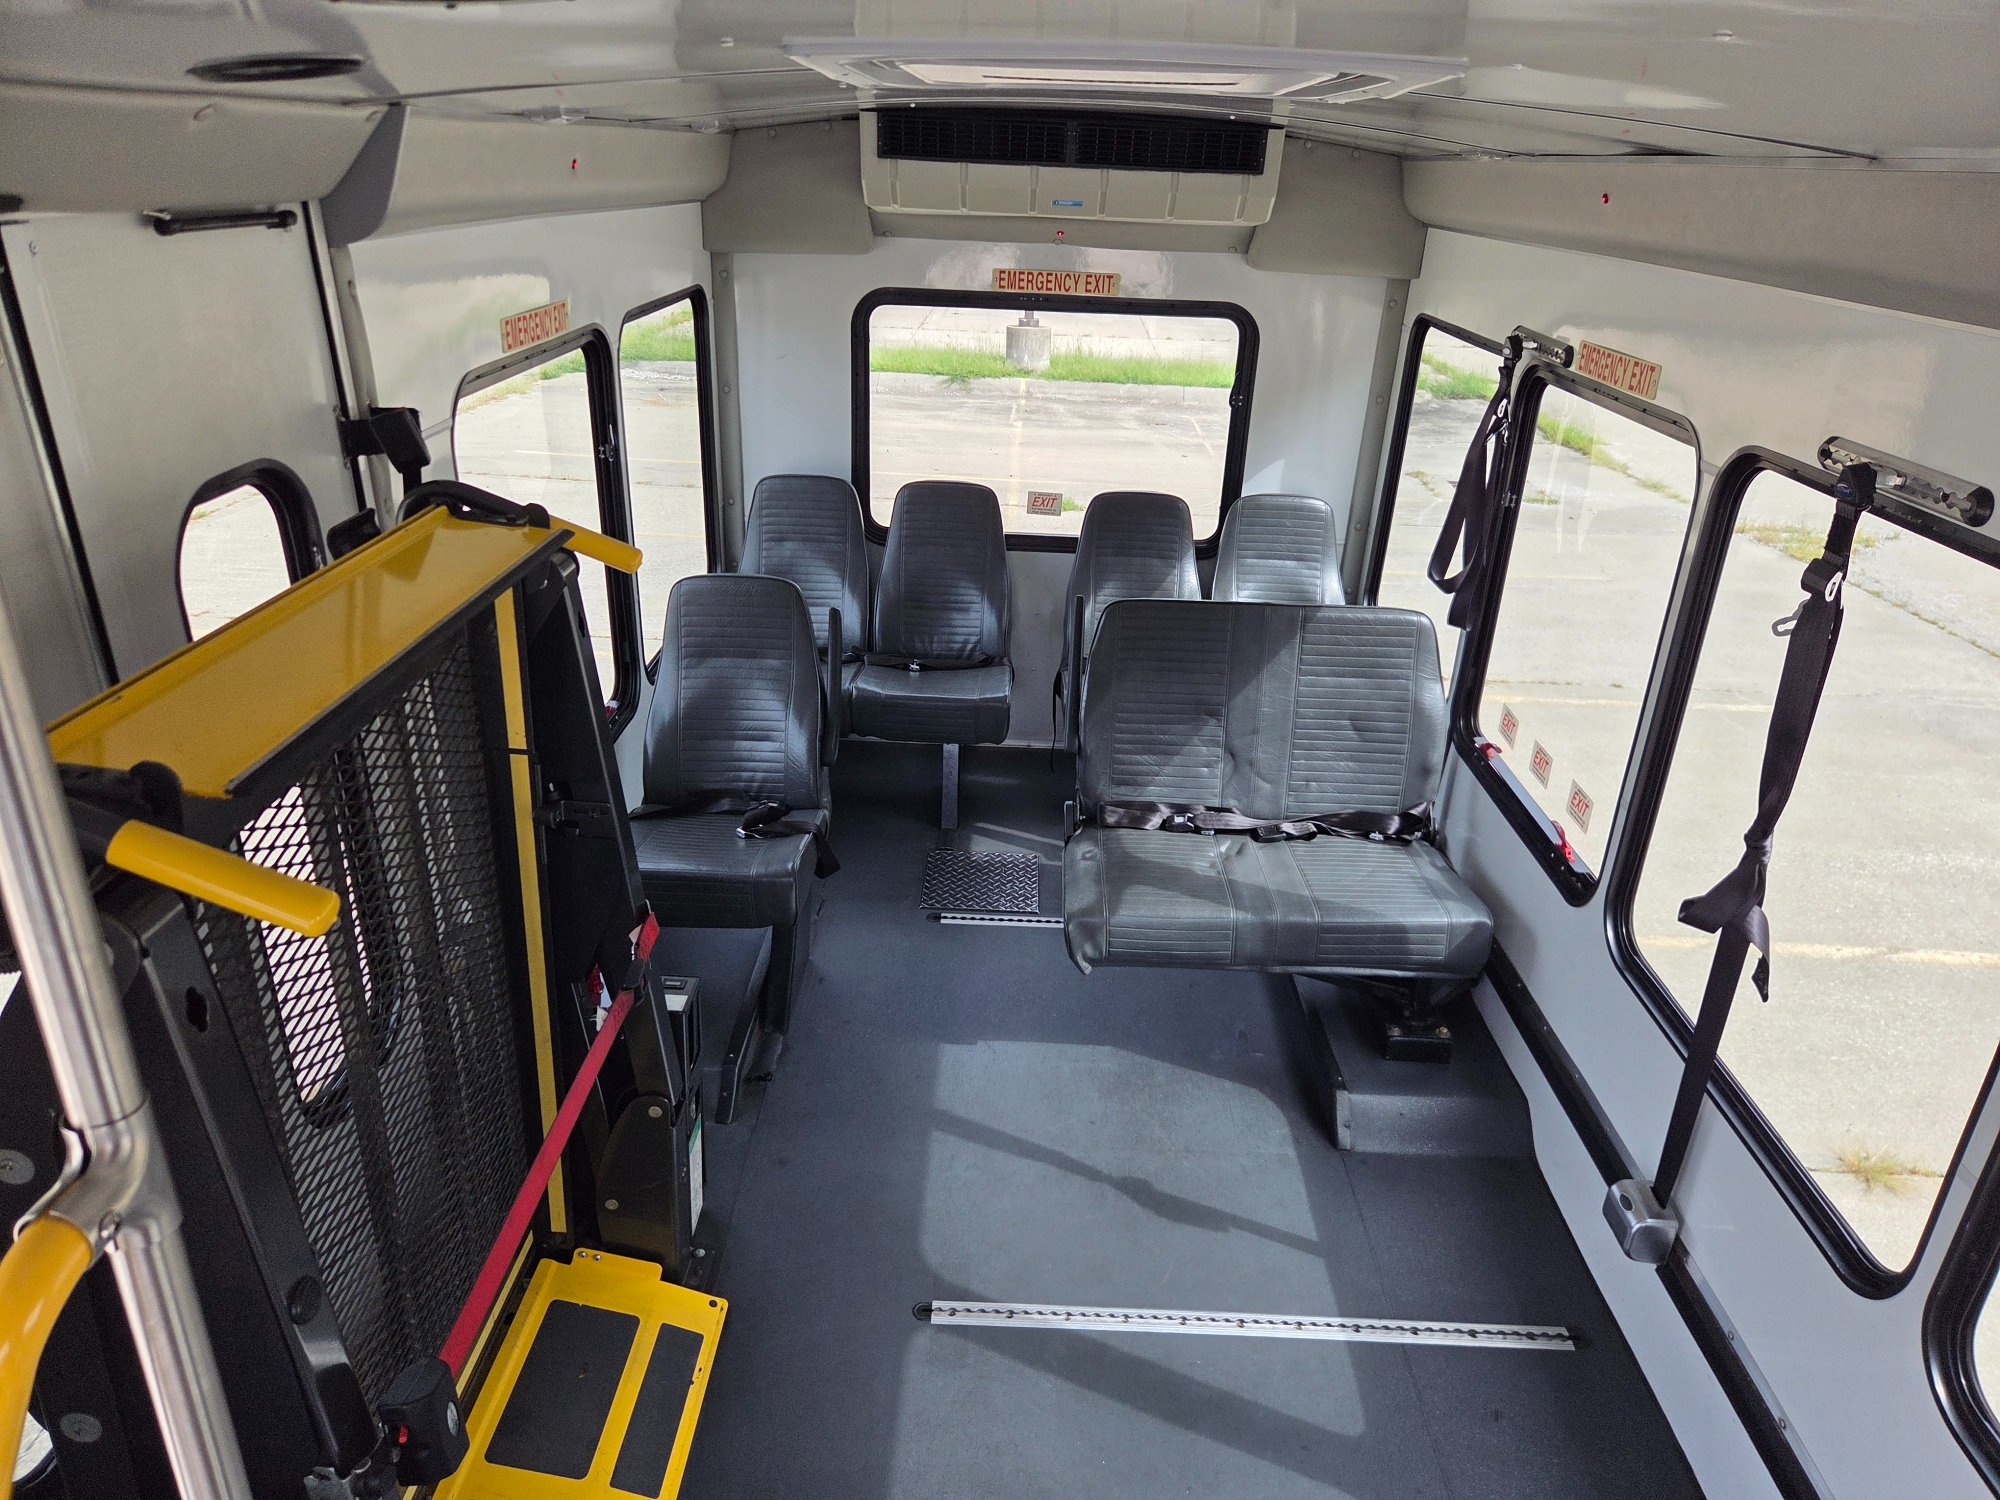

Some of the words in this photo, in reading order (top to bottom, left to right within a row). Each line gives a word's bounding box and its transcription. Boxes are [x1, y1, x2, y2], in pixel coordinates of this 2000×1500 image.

[998, 270, 1081, 293] EMERGENCY
[1084, 274, 1114, 294] EXIT
[504, 306, 552, 350] EMERGENCY
[553, 302, 567, 333] EXIT
[1578, 343, 1630, 388] EMERGENCY
[1627, 360, 1656, 396] EXIT
[1031, 496, 1057, 508] EXIT
[1501, 713, 1516, 734] EXIT
[1532, 751, 1549, 773] EXIT
[1570, 791, 1590, 817] EXIT
